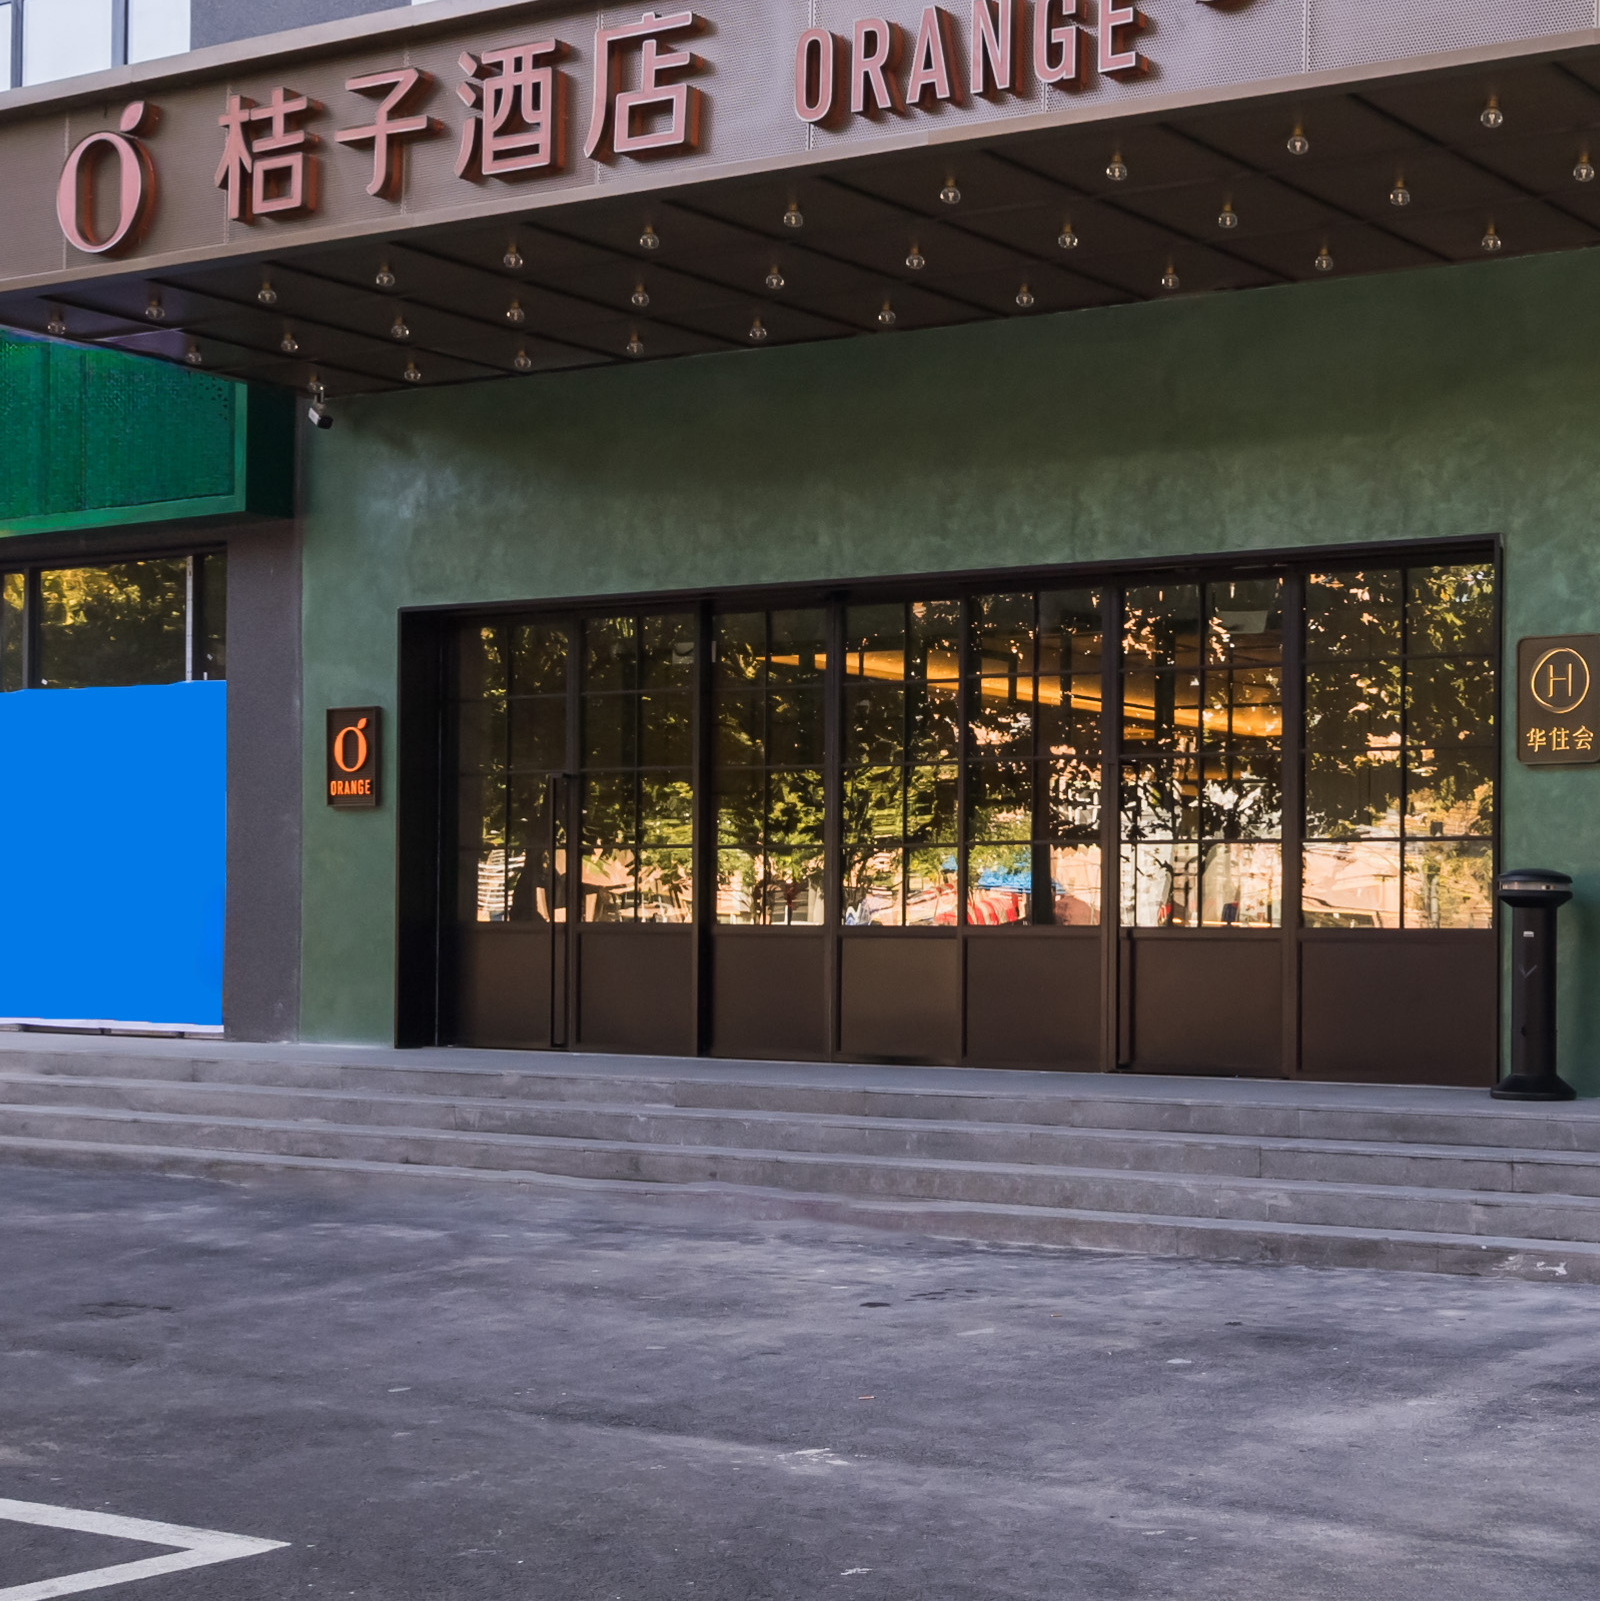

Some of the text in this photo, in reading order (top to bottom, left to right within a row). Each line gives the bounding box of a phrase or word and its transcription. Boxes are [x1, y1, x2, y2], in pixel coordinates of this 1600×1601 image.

[215, 11, 700, 221] 桔子酒店
[1526, 725, 1594, 752] 华住会
[330, 779, 371, 796] ORANGE
